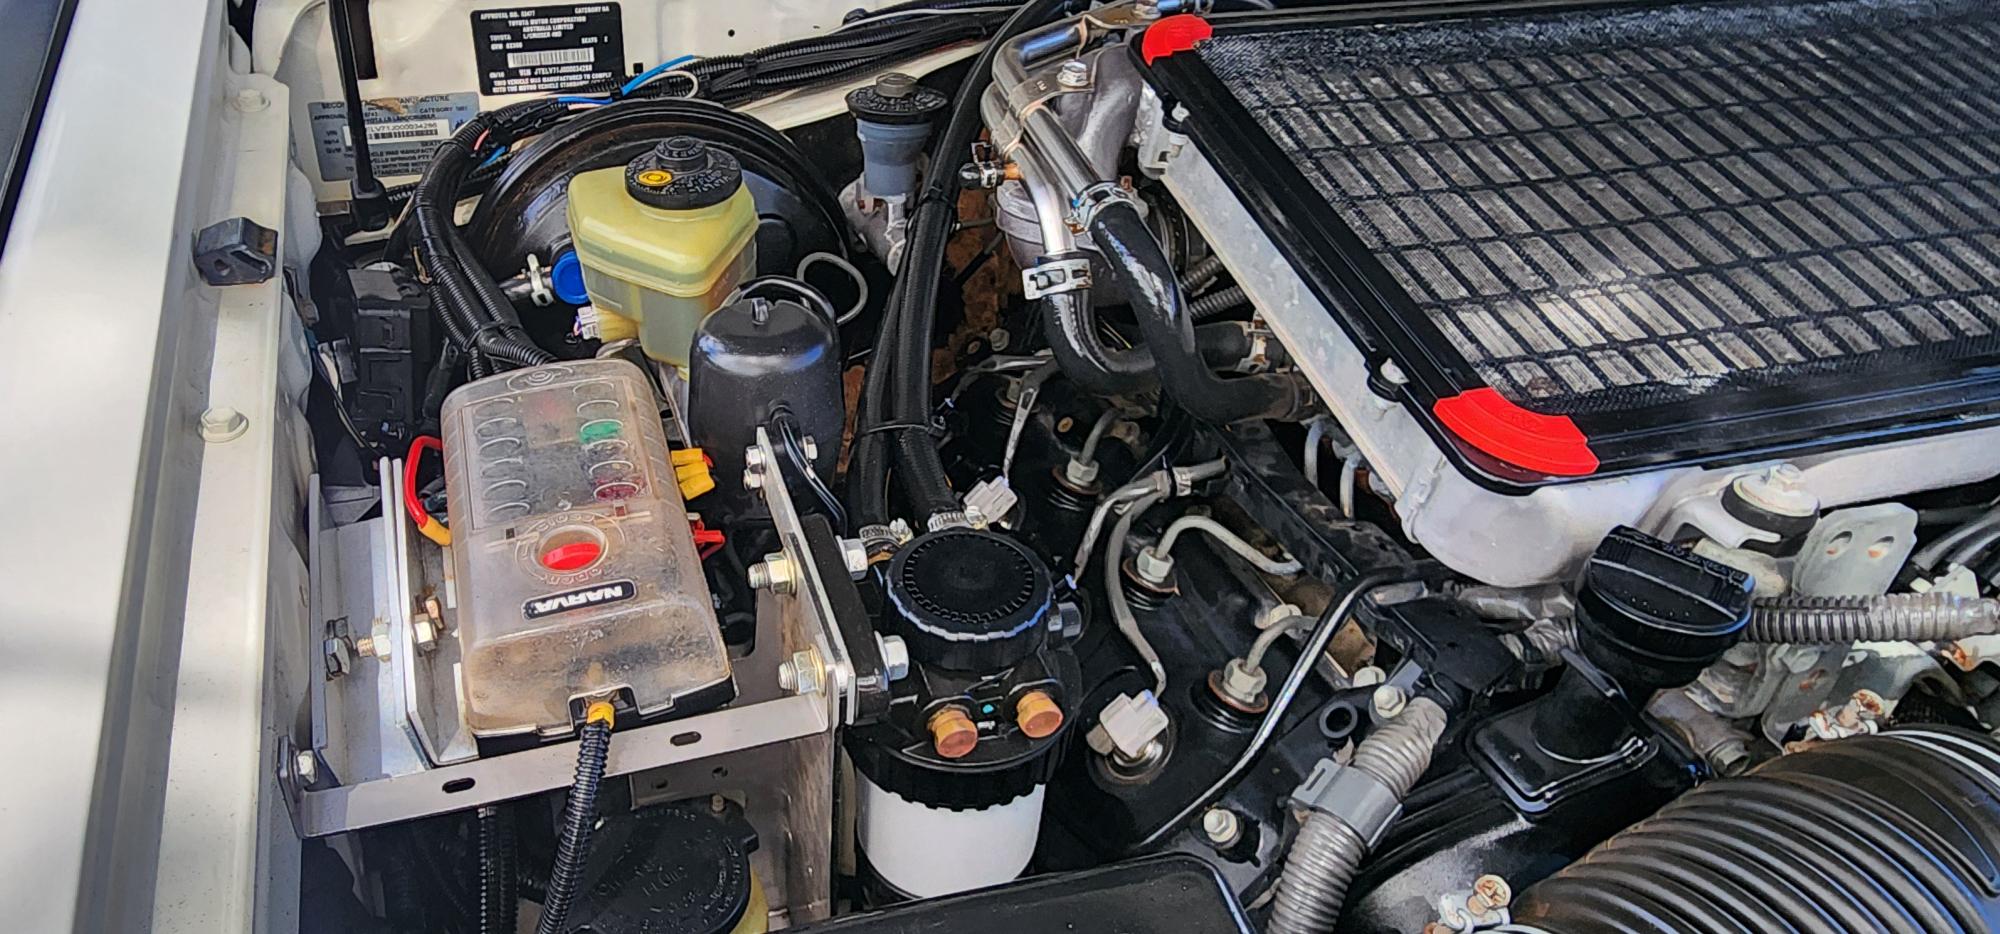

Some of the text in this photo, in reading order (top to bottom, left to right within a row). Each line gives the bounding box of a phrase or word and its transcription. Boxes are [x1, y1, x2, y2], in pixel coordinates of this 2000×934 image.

[480, 12, 508, 20] APPROVAL
[508, 19, 529, 27] TOYOTA
[549, 16, 586, 24] CORPORATION
[522, 23, 574, 33] AUSTRALIA LIMITED
[489, 34, 512, 42] TOYOTA
[507, 78, 529, 86] VEHICLE
[542, 74, 583, 83] MANUFACTURED
[591, 72, 612, 80] COMPLY
[537, 82, 558, 90] VEHICLE
[535, 585, 623, 614] NARVA
